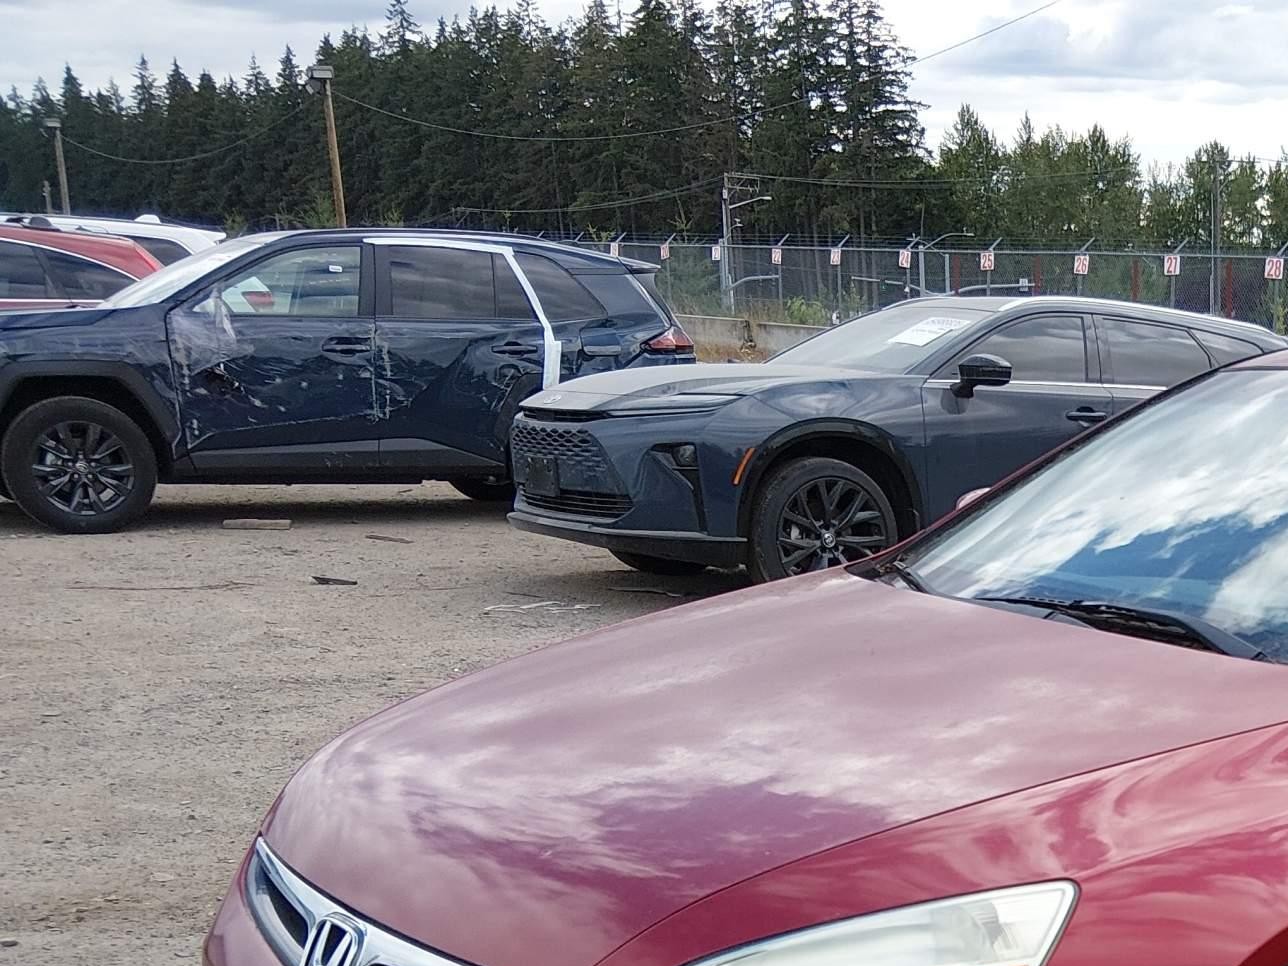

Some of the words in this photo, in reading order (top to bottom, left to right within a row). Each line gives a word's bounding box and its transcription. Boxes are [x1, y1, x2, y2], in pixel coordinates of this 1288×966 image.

[982, 254, 993, 269] 25
[1075, 257, 1087, 273] 26
[1167, 256, 1178, 273] 27
[1267, 260, 1281, 278] 28
